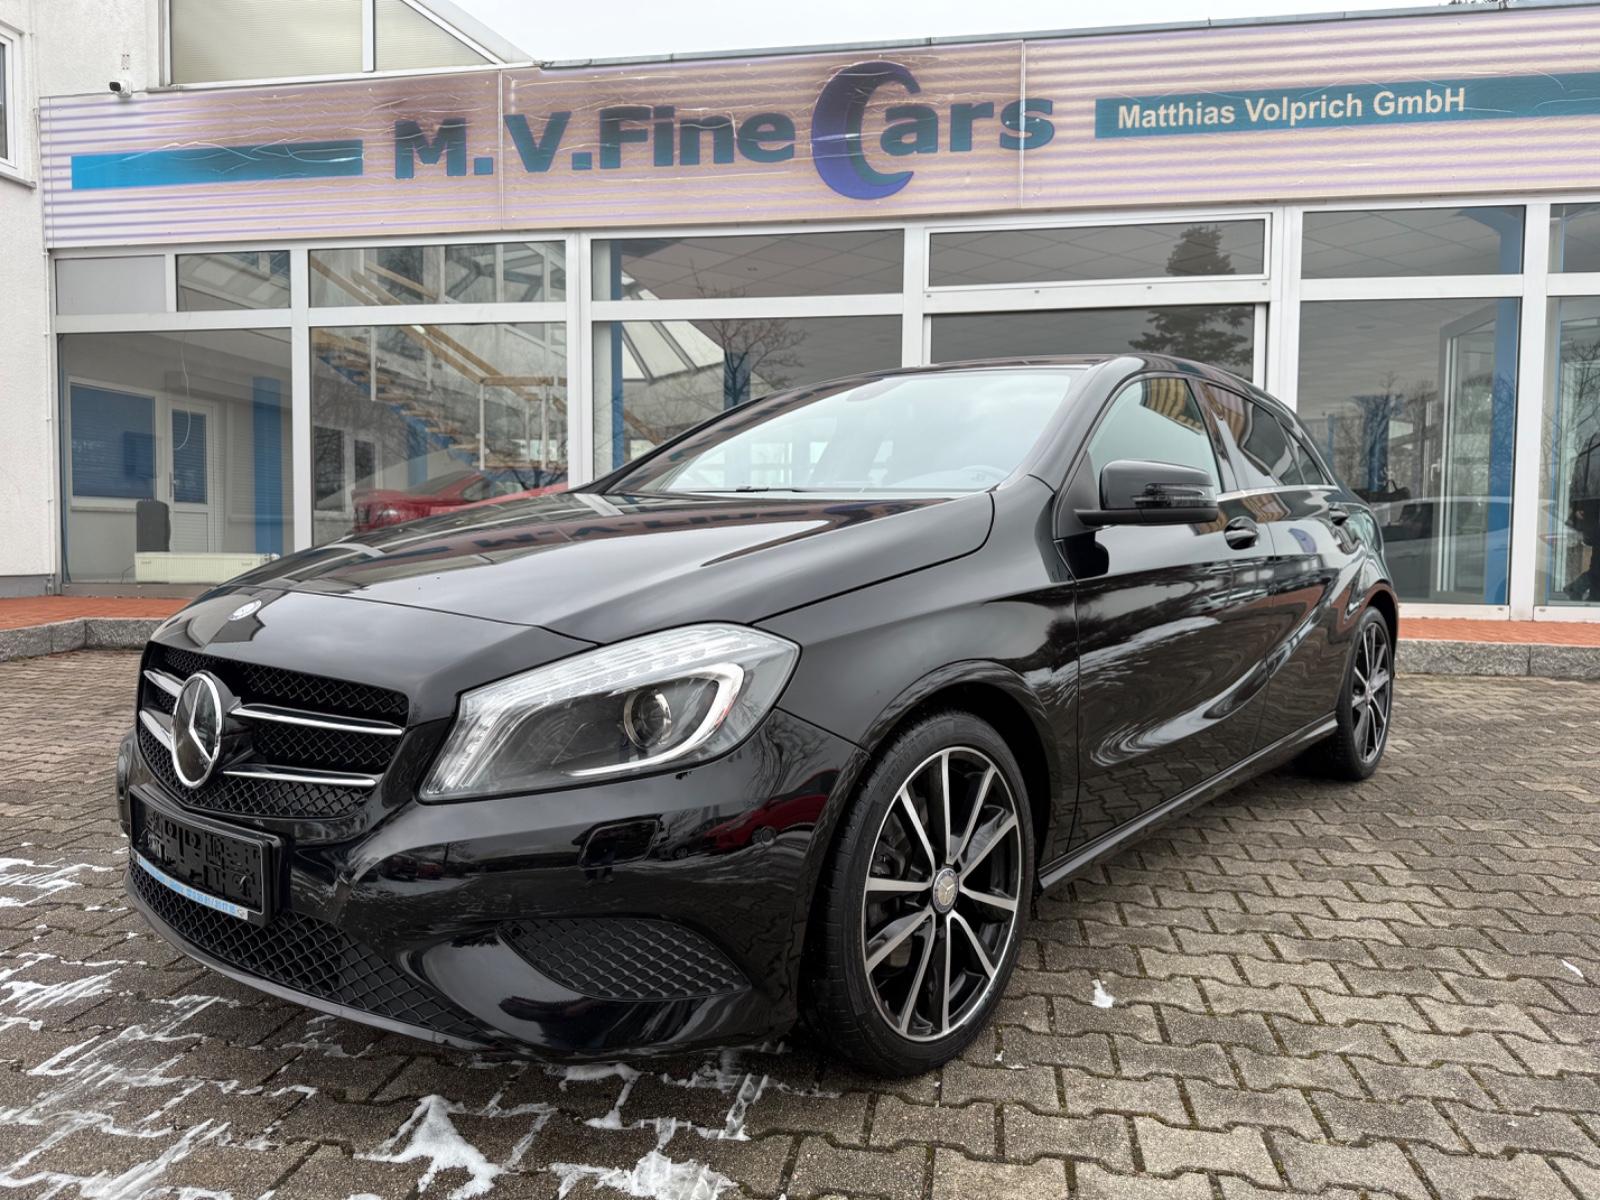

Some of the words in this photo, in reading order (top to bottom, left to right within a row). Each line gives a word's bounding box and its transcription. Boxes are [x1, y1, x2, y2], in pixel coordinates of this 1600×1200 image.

[810, 61, 1055, 200] Cars
[1117, 101, 1236, 129] Matthias
[1245, 94, 1363, 126] Volprich
[1373, 87, 1466, 116] GmbH
